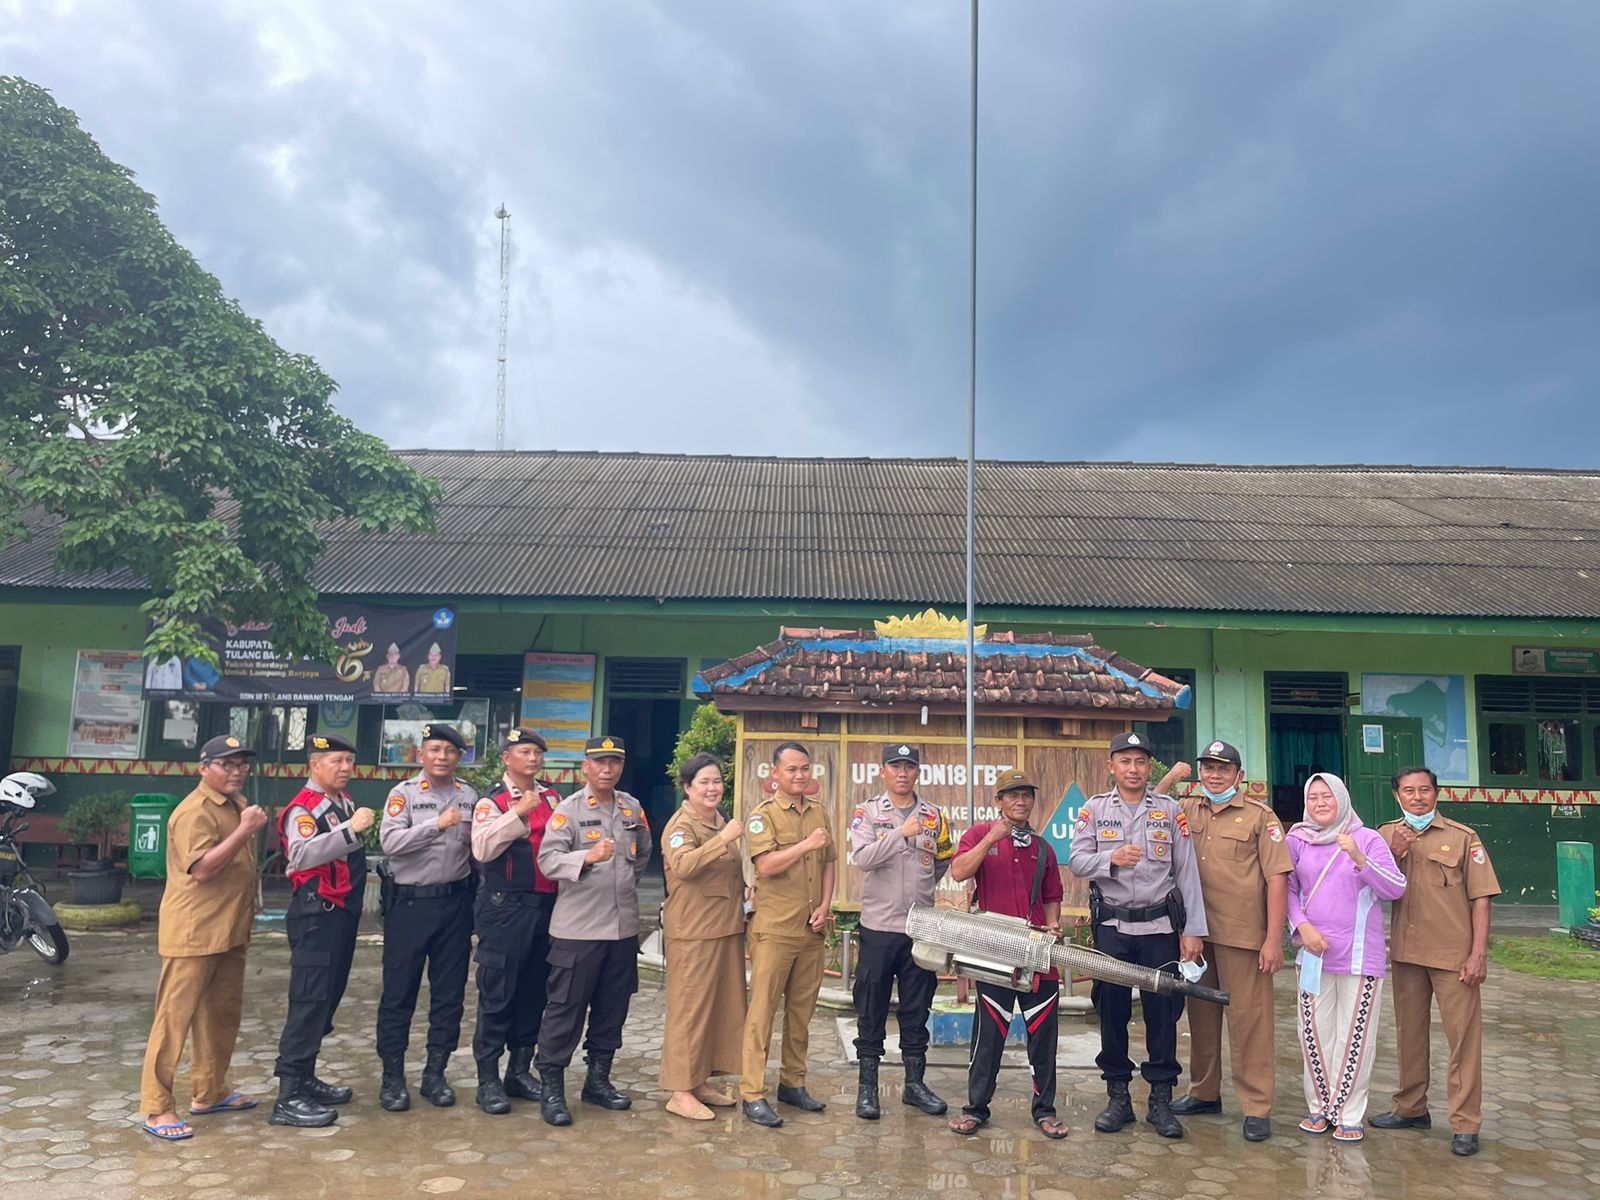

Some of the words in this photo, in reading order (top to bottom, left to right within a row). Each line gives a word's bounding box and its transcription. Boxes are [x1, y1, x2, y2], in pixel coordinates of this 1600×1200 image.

[225, 650, 262, 660] TULANG
[249, 669, 287, 678] Lampung
[293, 693, 324, 701] BAWANG
[325, 693, 354, 702] TENGAH
[1097, 820, 1122, 828] SOIM
[1146, 820, 1171, 829] POLRI
